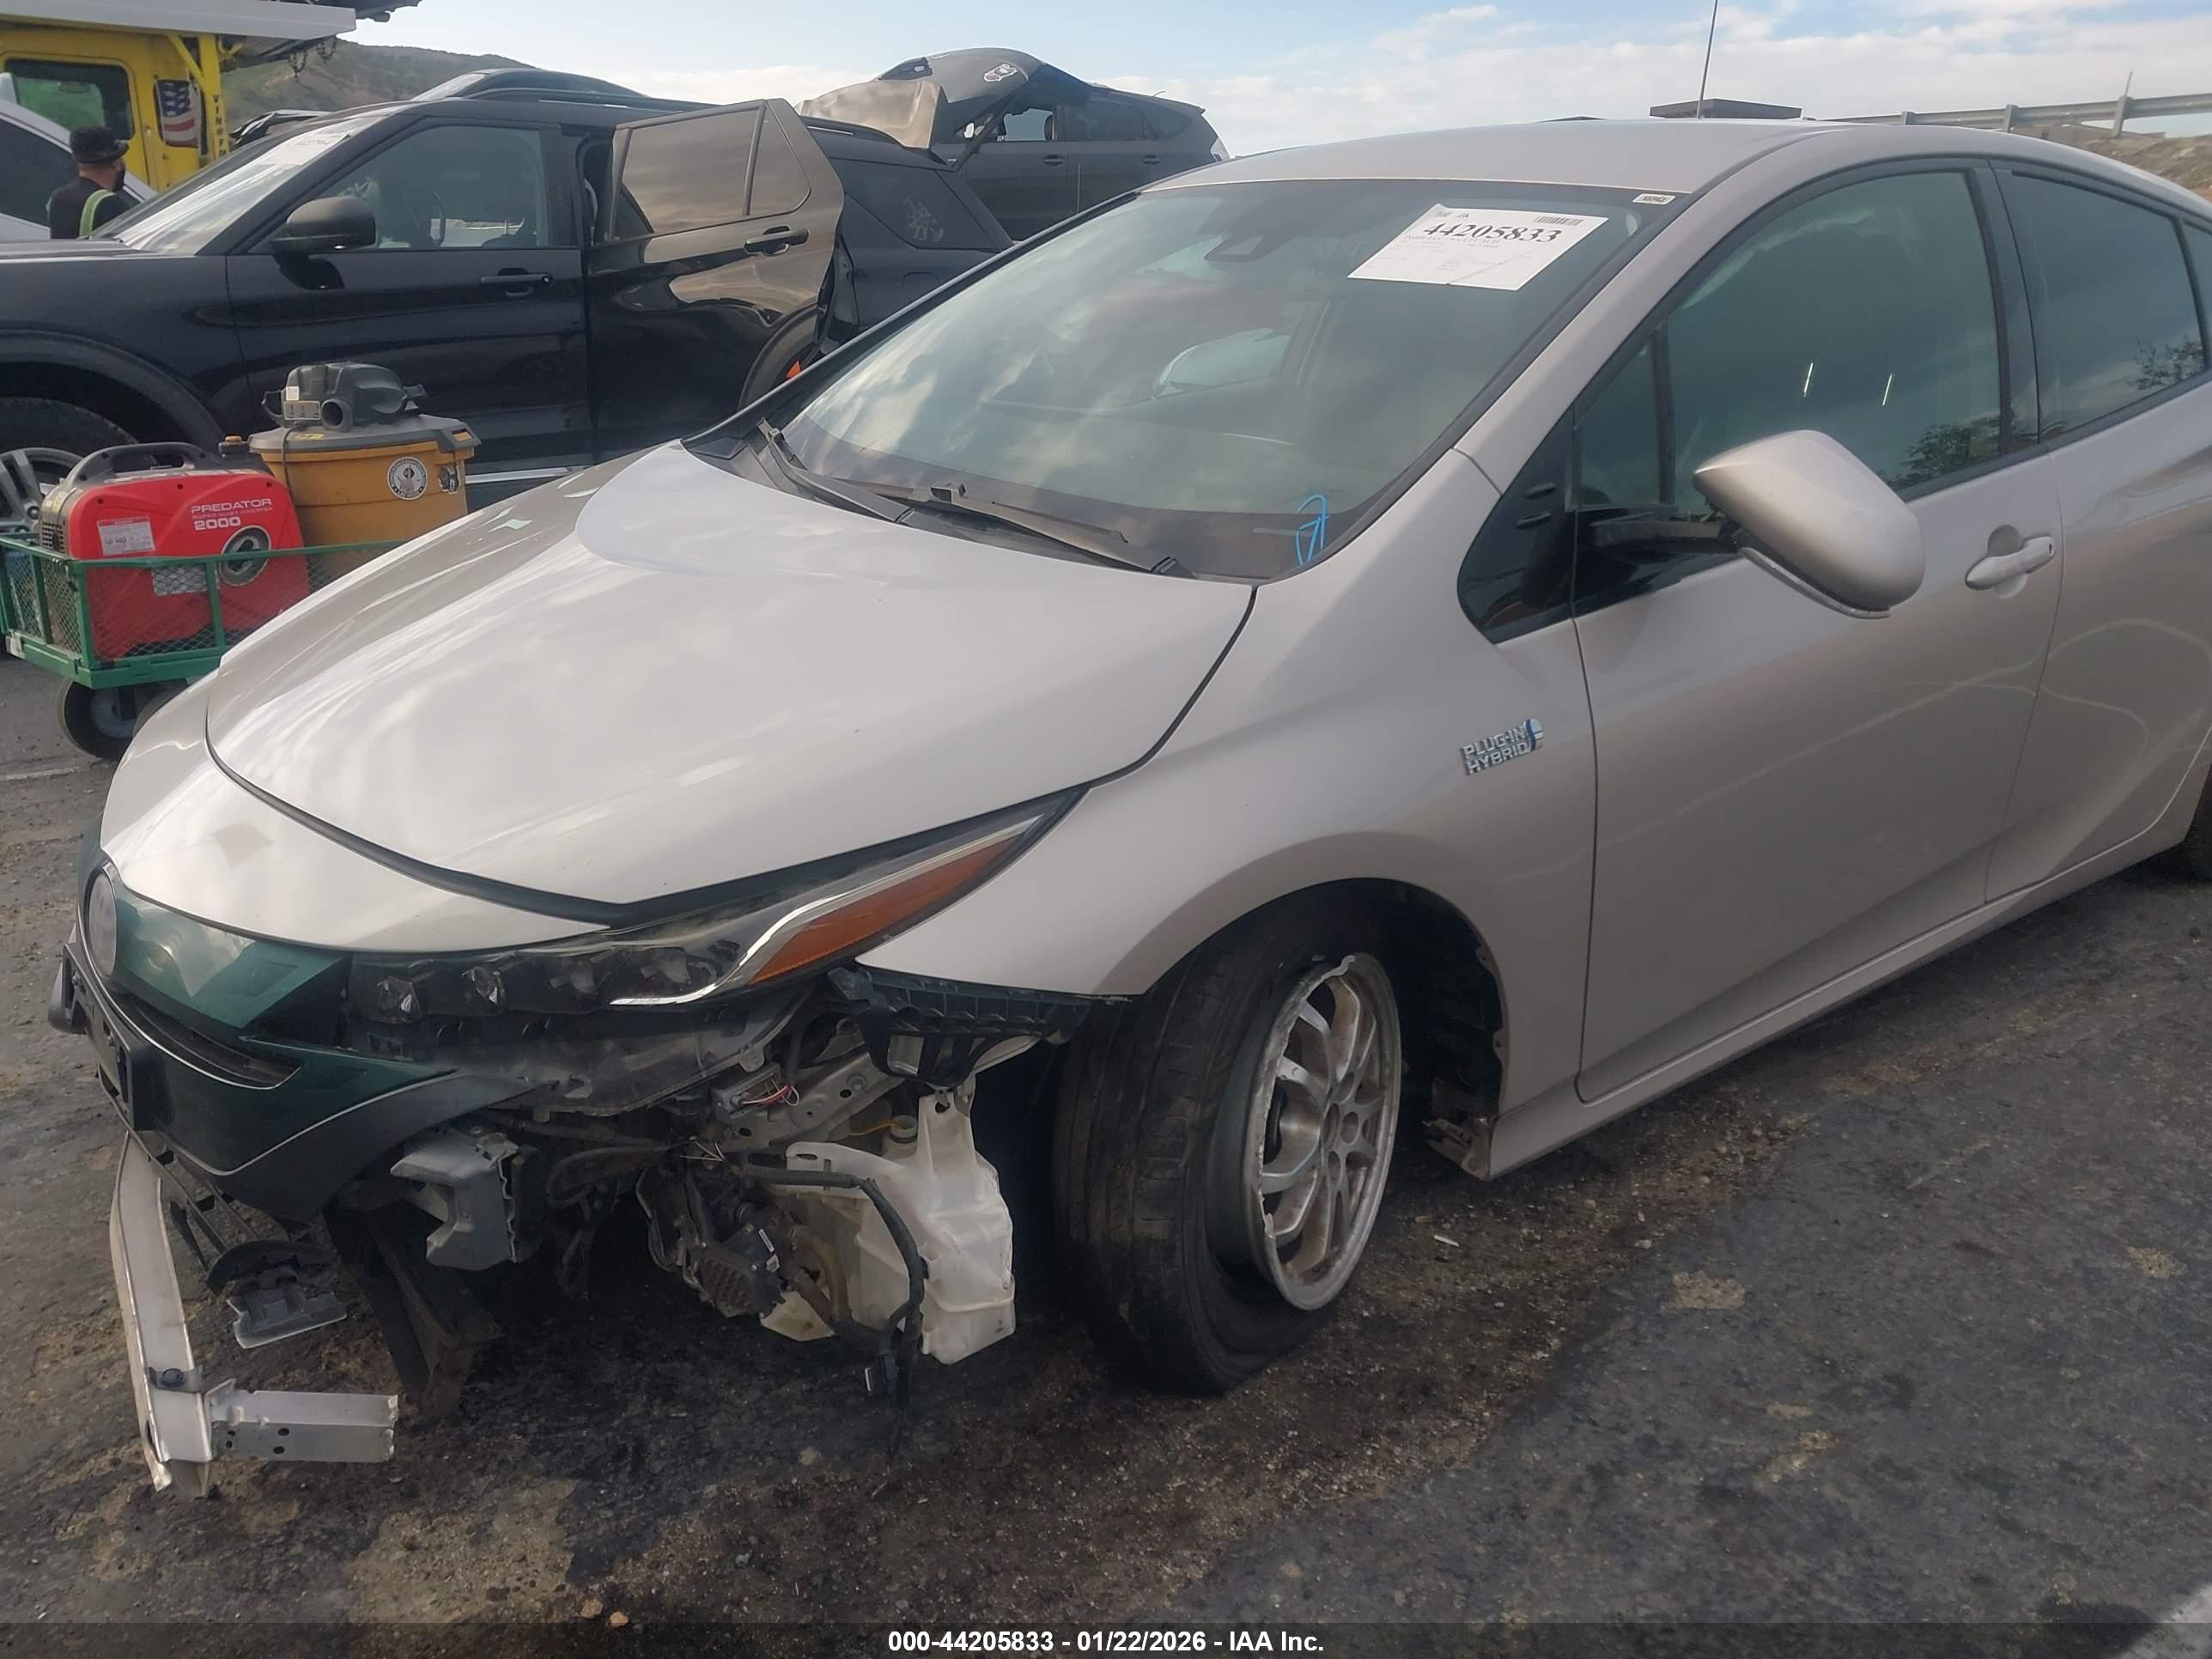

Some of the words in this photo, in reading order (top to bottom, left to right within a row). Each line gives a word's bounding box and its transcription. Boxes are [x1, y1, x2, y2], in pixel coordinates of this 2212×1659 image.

[1423, 222, 1562, 243] 44205833
[191, 498, 272, 514] PREDATOR
[194, 516, 240, 531] 2000
[1466, 741, 1528, 774] HYBRID
